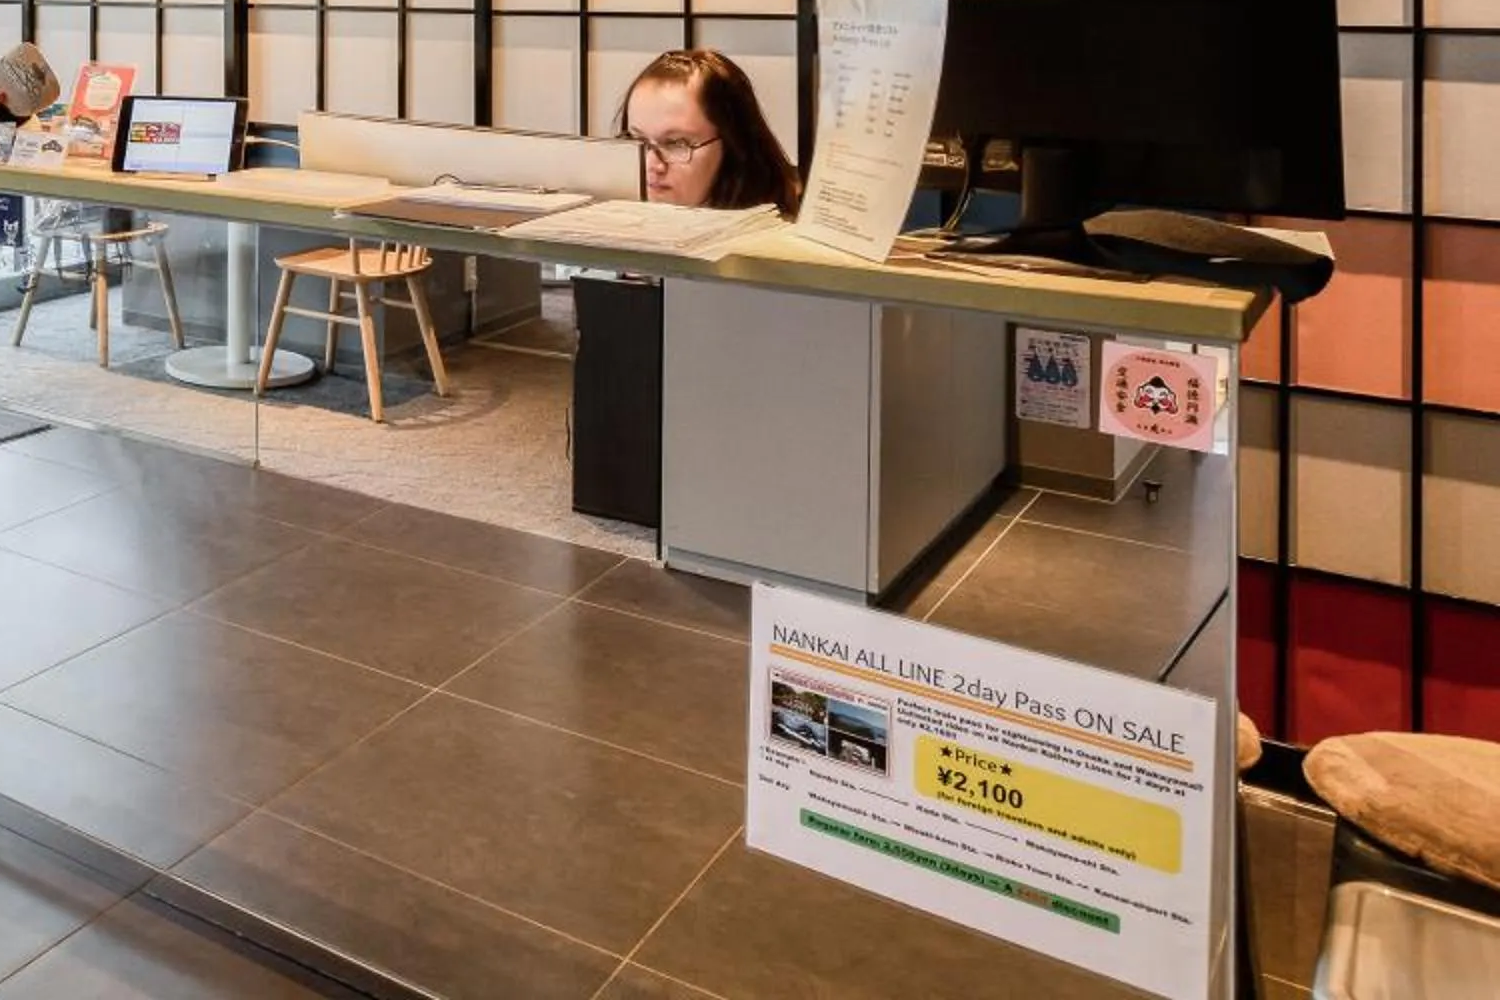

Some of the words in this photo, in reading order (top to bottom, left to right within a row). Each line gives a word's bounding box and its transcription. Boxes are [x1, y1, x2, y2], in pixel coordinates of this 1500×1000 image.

[772, 624, 848, 661] NANKAI
[856, 647, 891, 673] ALL
[899, 658, 944, 688] LINE
[952, 673, 1007, 709] 2day
[1014, 690, 1066, 721] Pass
[1074, 706, 1113, 735] ON
[1122, 719, 1185, 756] SALE
[955, 747, 997, 773] Price
[936, 764, 1023, 813] ¥2,100
